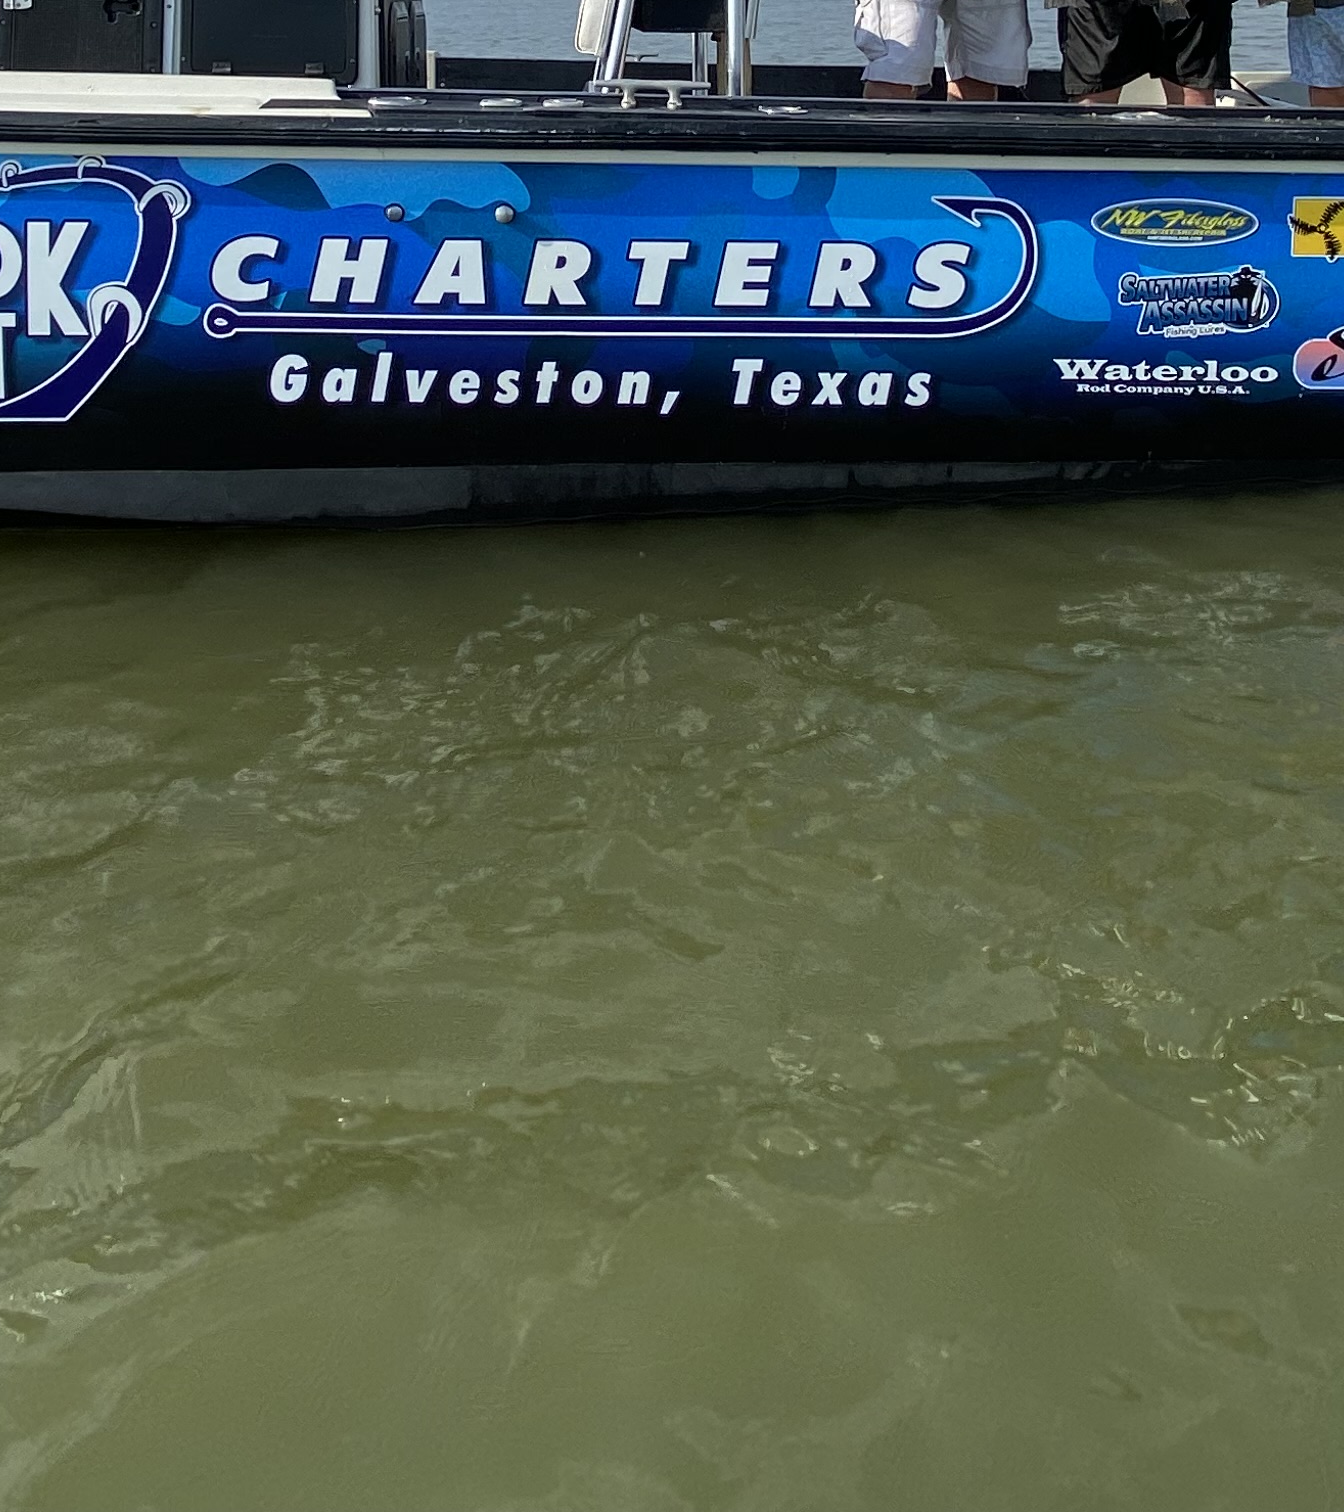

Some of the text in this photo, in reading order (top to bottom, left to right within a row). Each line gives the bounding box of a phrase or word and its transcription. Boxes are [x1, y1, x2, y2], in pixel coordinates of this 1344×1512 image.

[210, 236, 973, 309] CHARTERS
[1120, 274, 1233, 303] SALTWATER
[1139, 297, 1249, 332] ASSASSIN
[1165, 325, 1225, 337] Fishing Lures
[269, 353, 933, 414] Galveston, Texas
[1053, 358, 1278, 382] Waterloo
[1076, 383, 1251, 395] Rod Company U.S.A.
